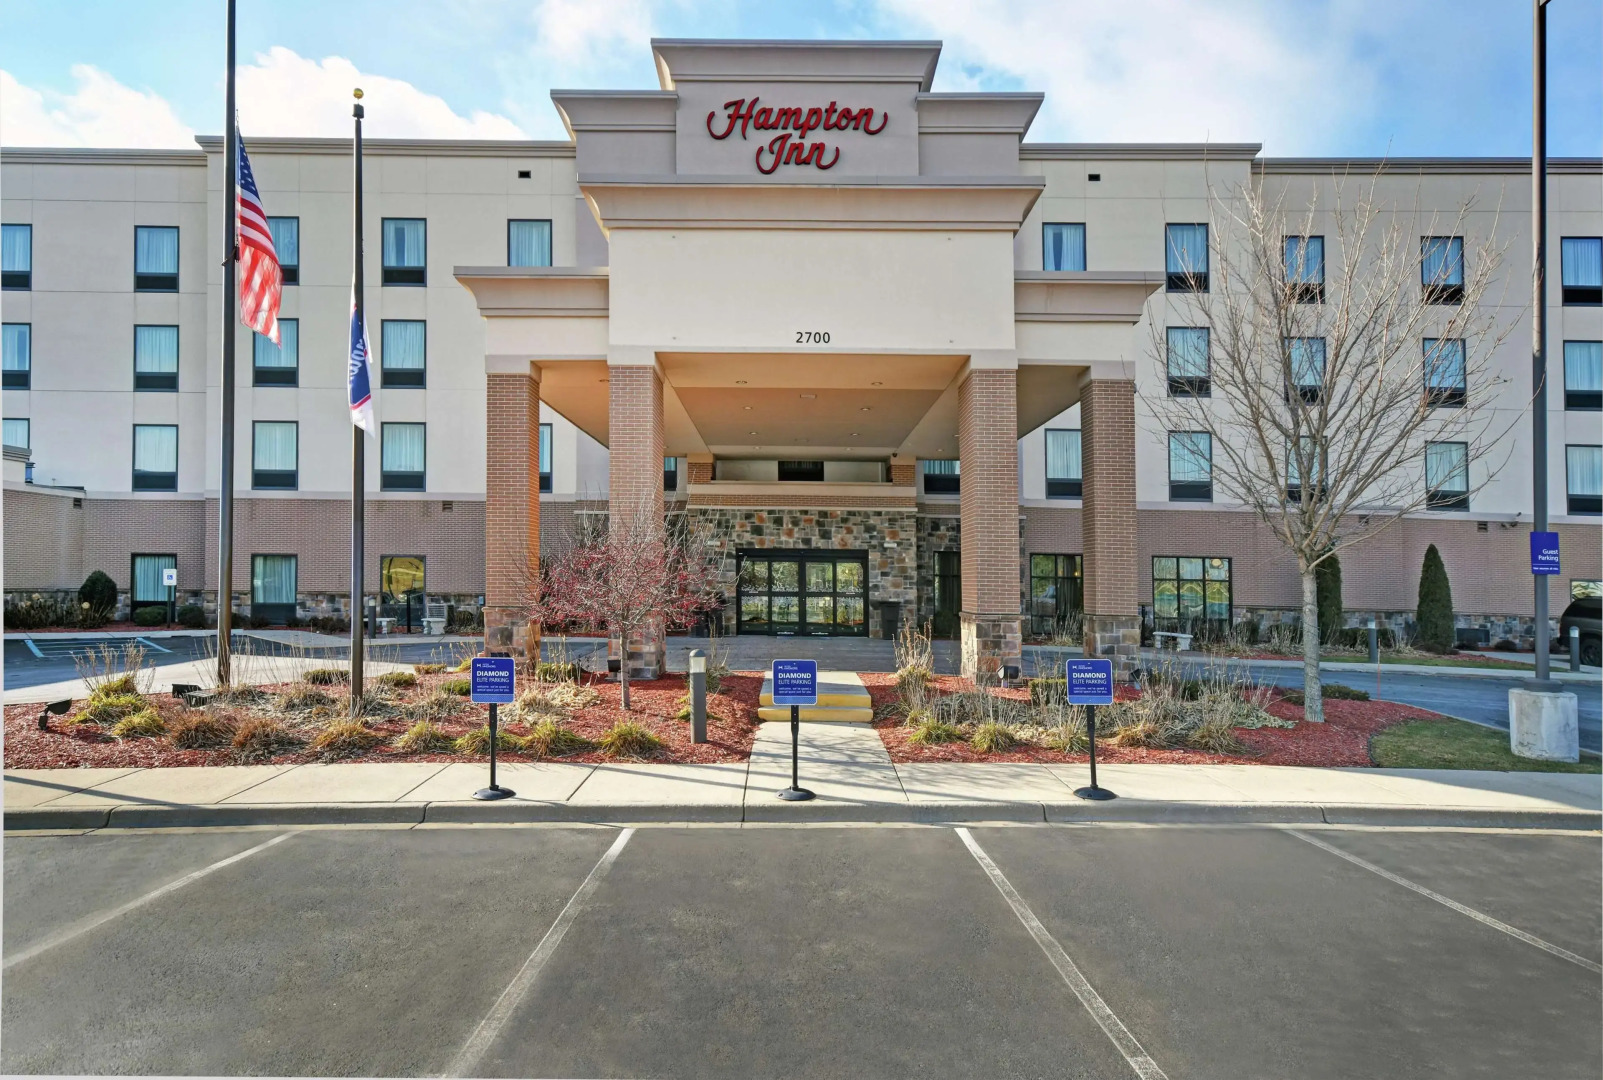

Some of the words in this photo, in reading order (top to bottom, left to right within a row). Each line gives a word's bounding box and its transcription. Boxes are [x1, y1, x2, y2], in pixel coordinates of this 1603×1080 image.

[706, 97, 889, 140] Hampton
[755, 133, 840, 175] Inn
[796, 331, 830, 344] 2700
